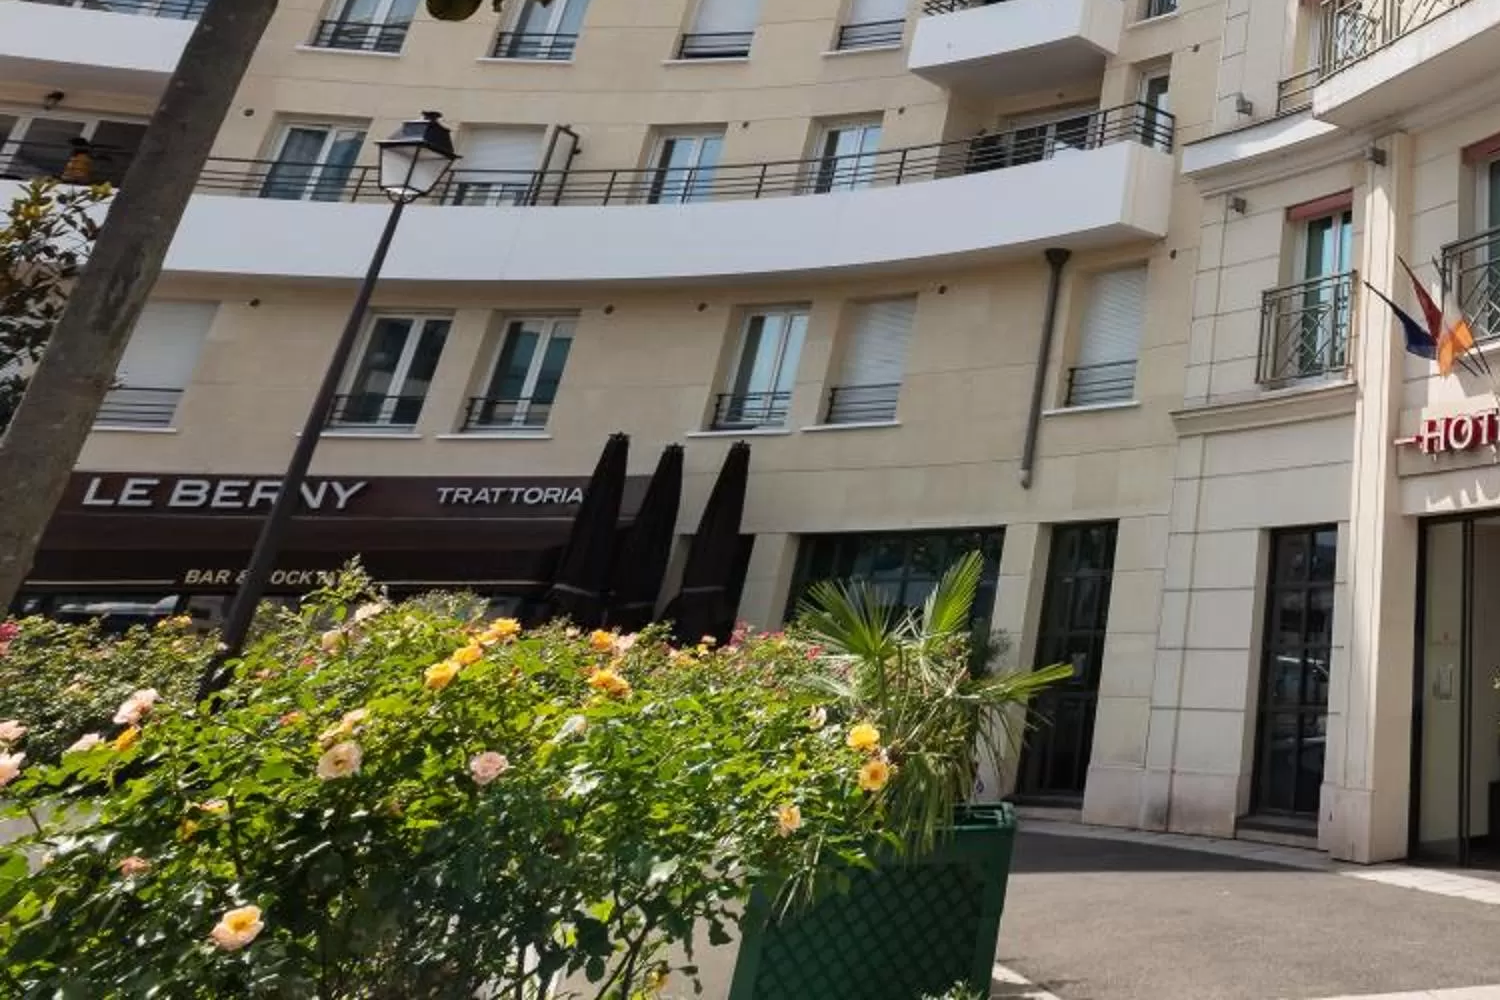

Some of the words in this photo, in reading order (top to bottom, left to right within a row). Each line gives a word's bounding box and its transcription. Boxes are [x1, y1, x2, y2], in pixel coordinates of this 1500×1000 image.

[82, 477, 160, 507] LE
[436, 487, 584, 505] TRATTORIA
[184, 569, 230, 585] BAR
